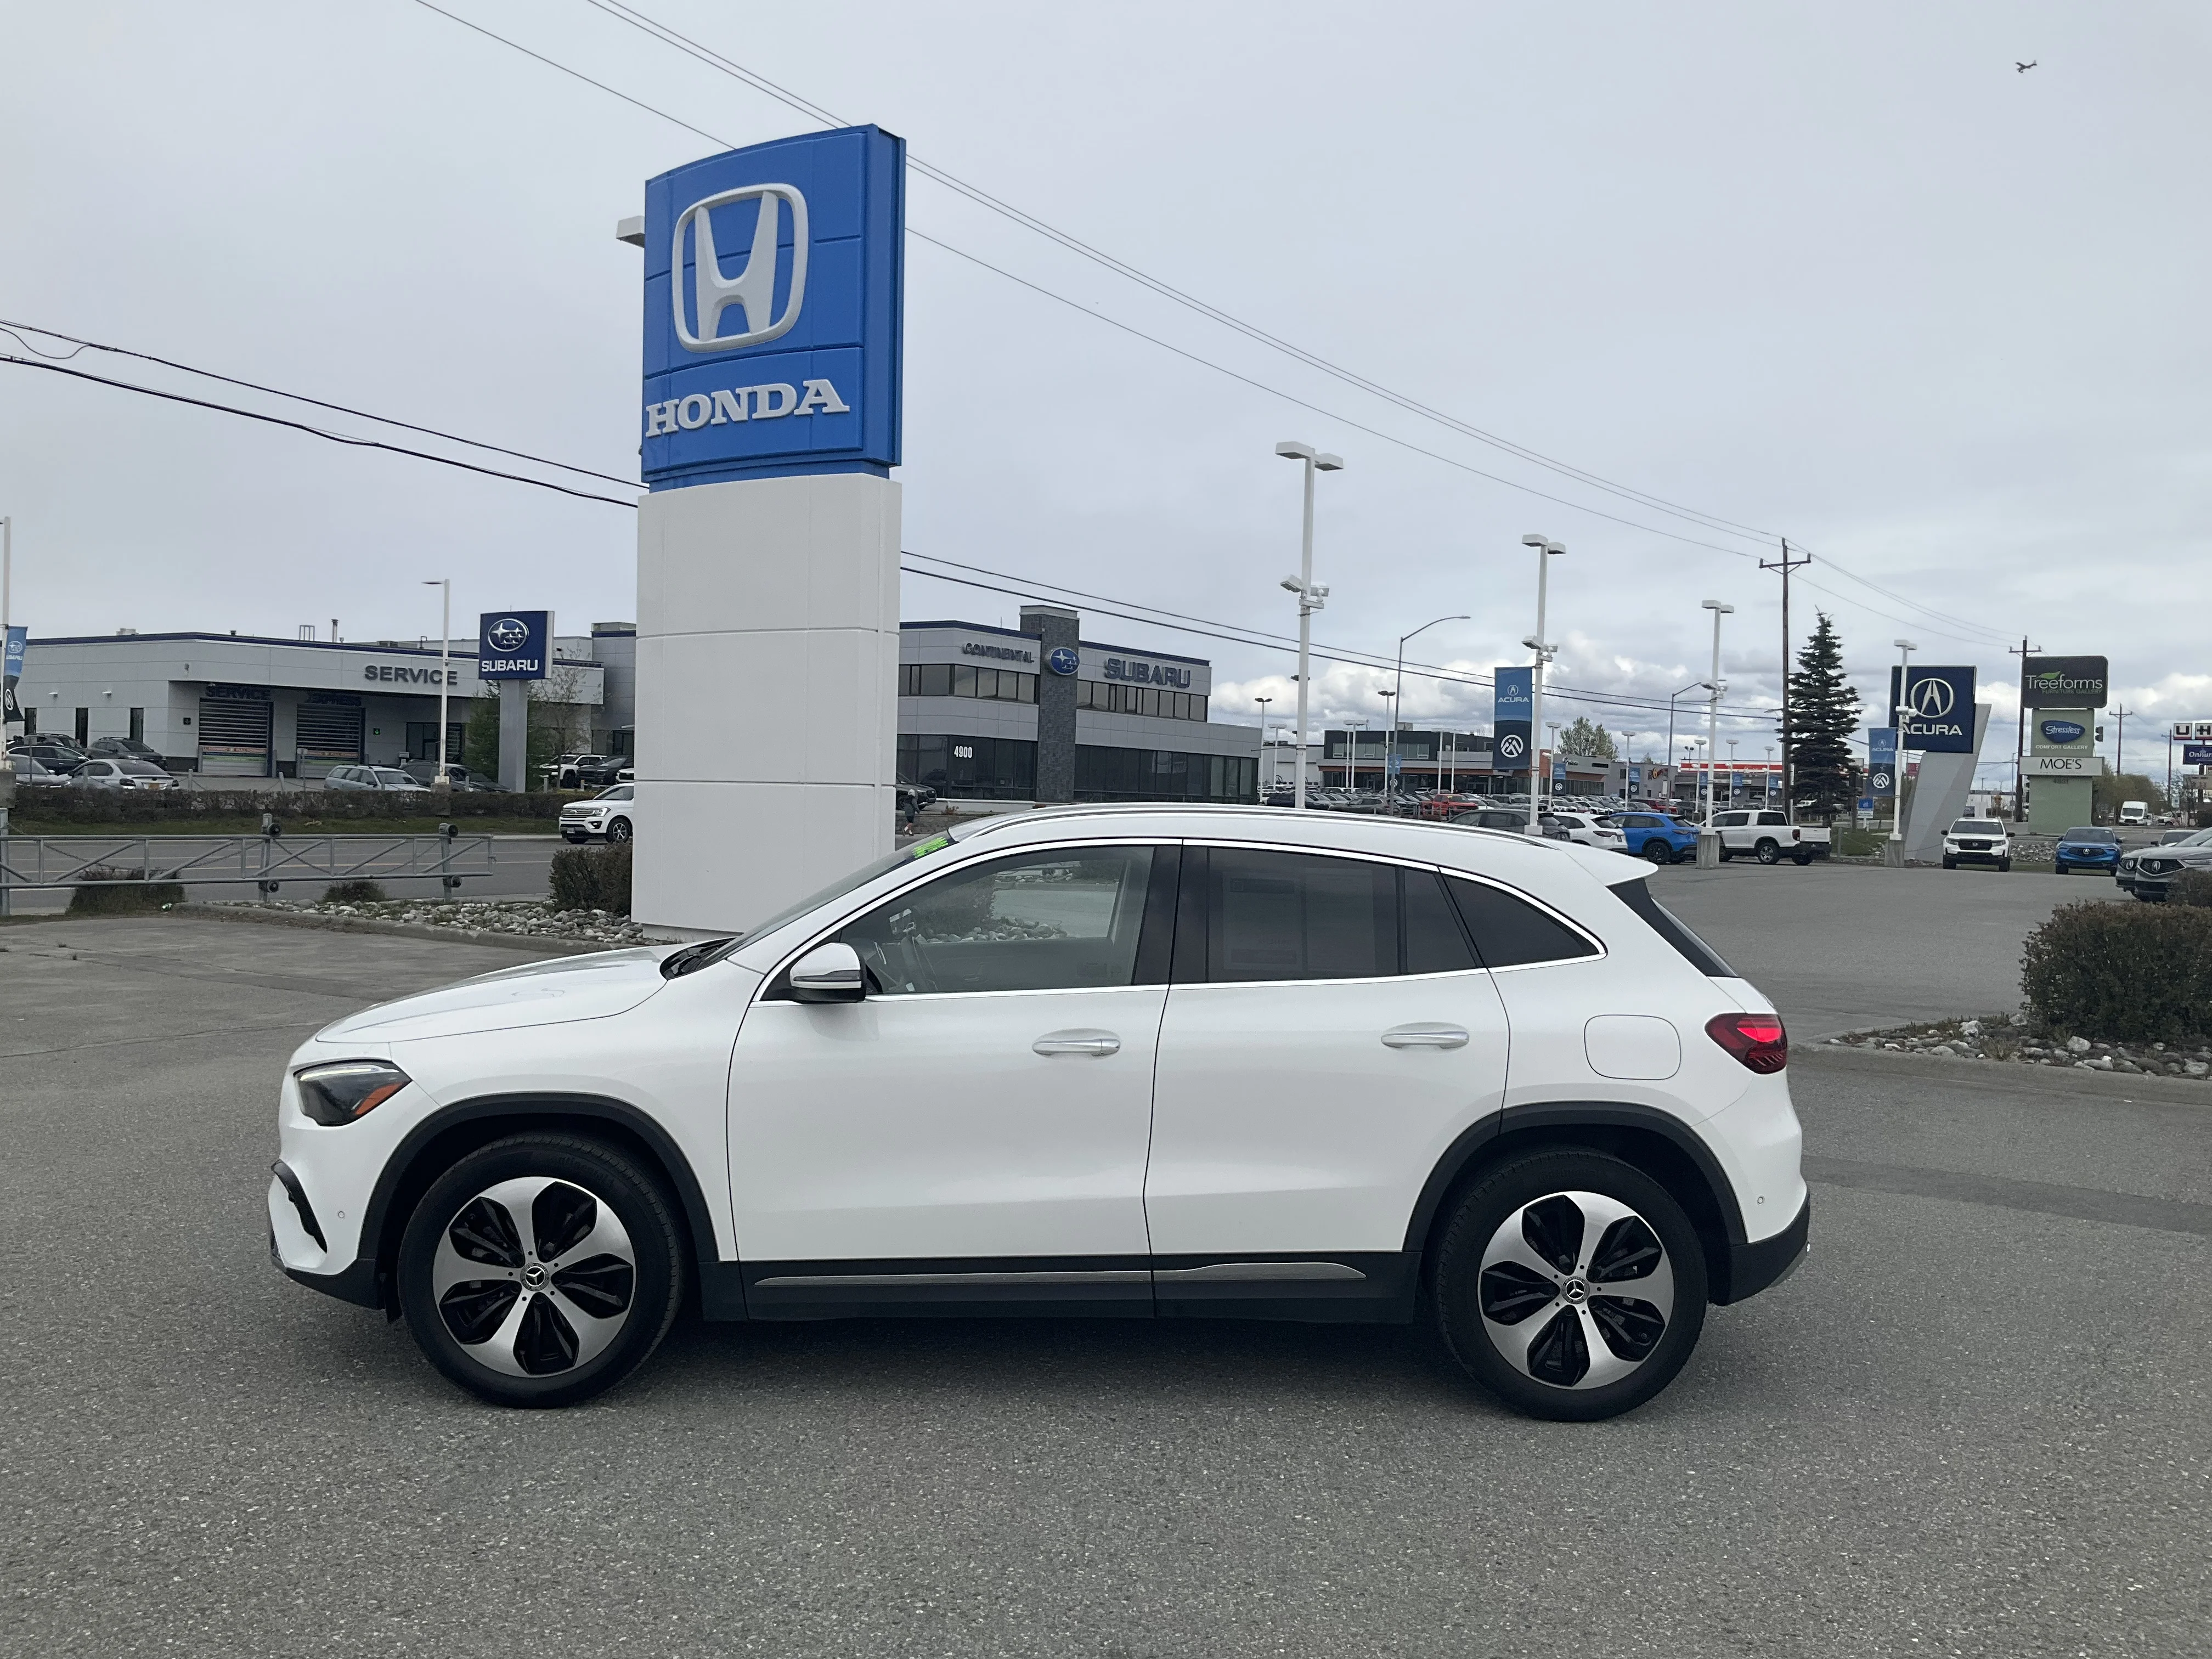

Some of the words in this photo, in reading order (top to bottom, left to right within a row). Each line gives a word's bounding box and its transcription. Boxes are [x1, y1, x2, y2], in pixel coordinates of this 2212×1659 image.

[645, 379, 850, 438] HONDA
[962, 642, 1035, 663] CONTINENTAL
[481, 659, 539, 673] SUBARU
[364, 665, 458, 686] SERVICE
[1104, 658, 1190, 689] SUBARU
[2025, 674, 2103, 689] Treeforms
[1897, 724, 1962, 735] ACURA
[2045, 725, 2082, 735] Stressless
[953, 746, 973, 758] 4900
[2040, 758, 2082, 770] MOE'S
